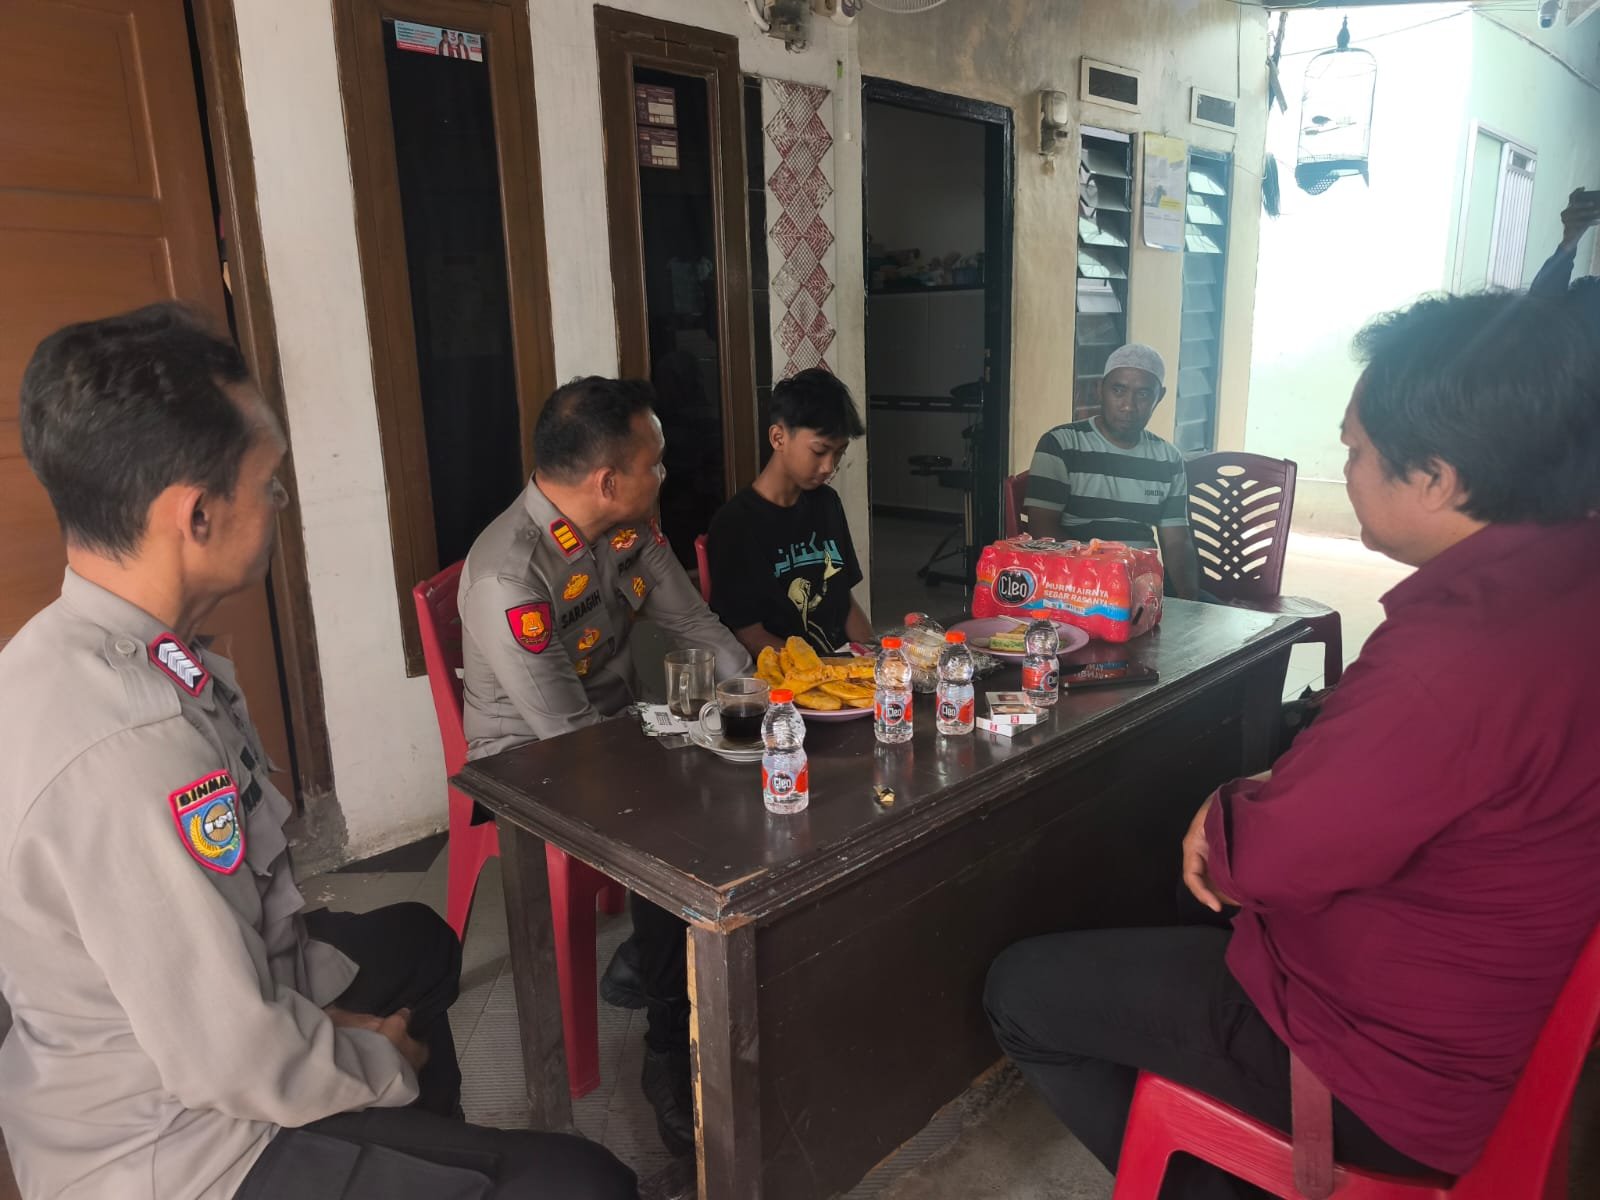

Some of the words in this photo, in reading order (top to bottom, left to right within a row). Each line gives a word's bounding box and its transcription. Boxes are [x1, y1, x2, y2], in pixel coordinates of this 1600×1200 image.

[1001, 576, 1028, 598] Cleo
[1045, 582, 1076, 593] MURNI
[1044, 590, 1070, 600] SEGAR
[561, 589, 602, 629] SARAGIH
[887, 708, 902, 717] Cleo
[773, 777, 792, 789] Cleo
